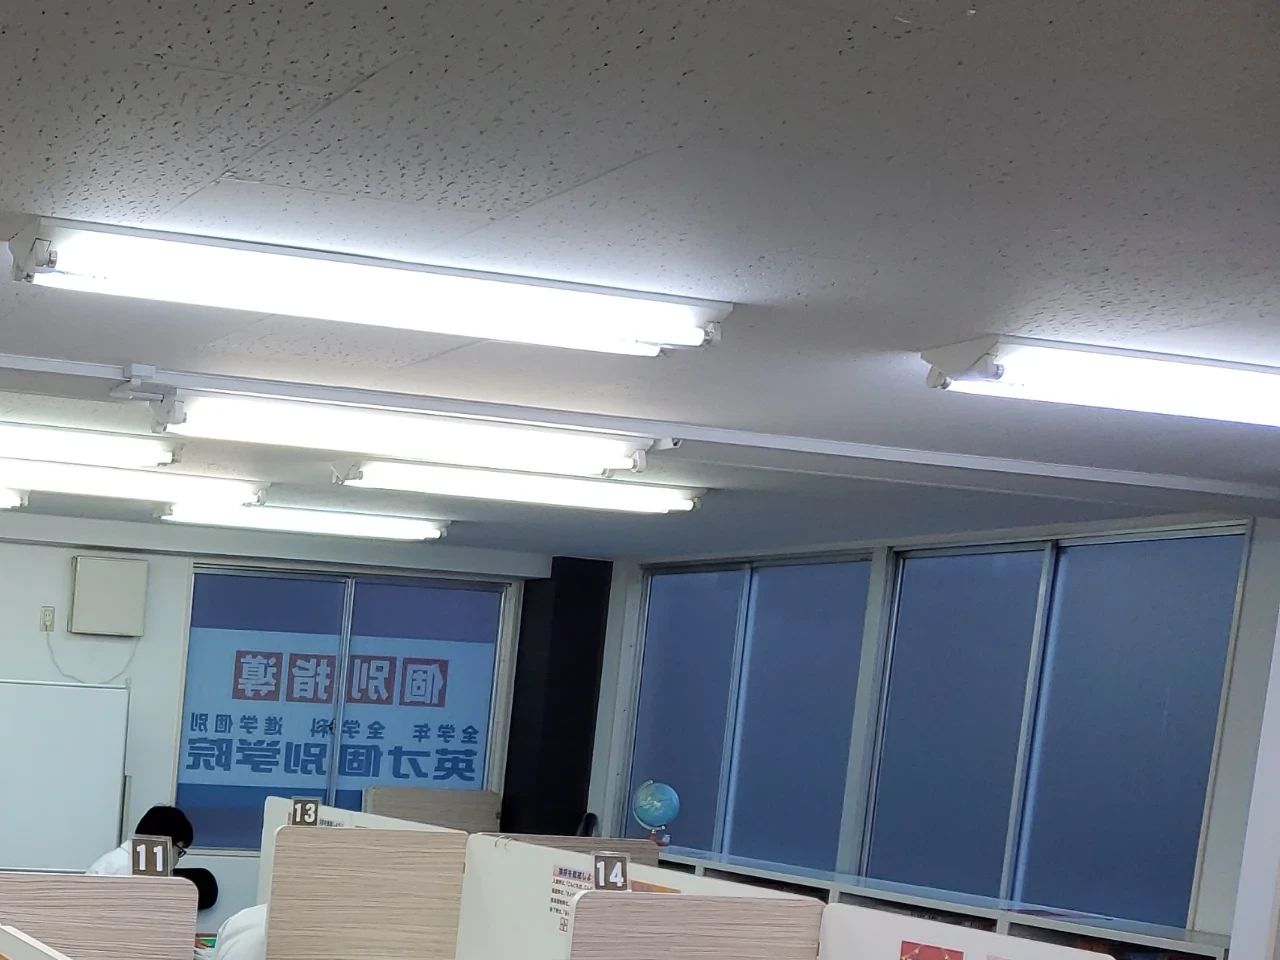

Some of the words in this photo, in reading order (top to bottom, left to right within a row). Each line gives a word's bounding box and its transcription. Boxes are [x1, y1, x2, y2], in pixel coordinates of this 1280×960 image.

[294, 803, 316, 823] 13
[136, 844, 163, 872] 11
[596, 861, 624, 888] 14
